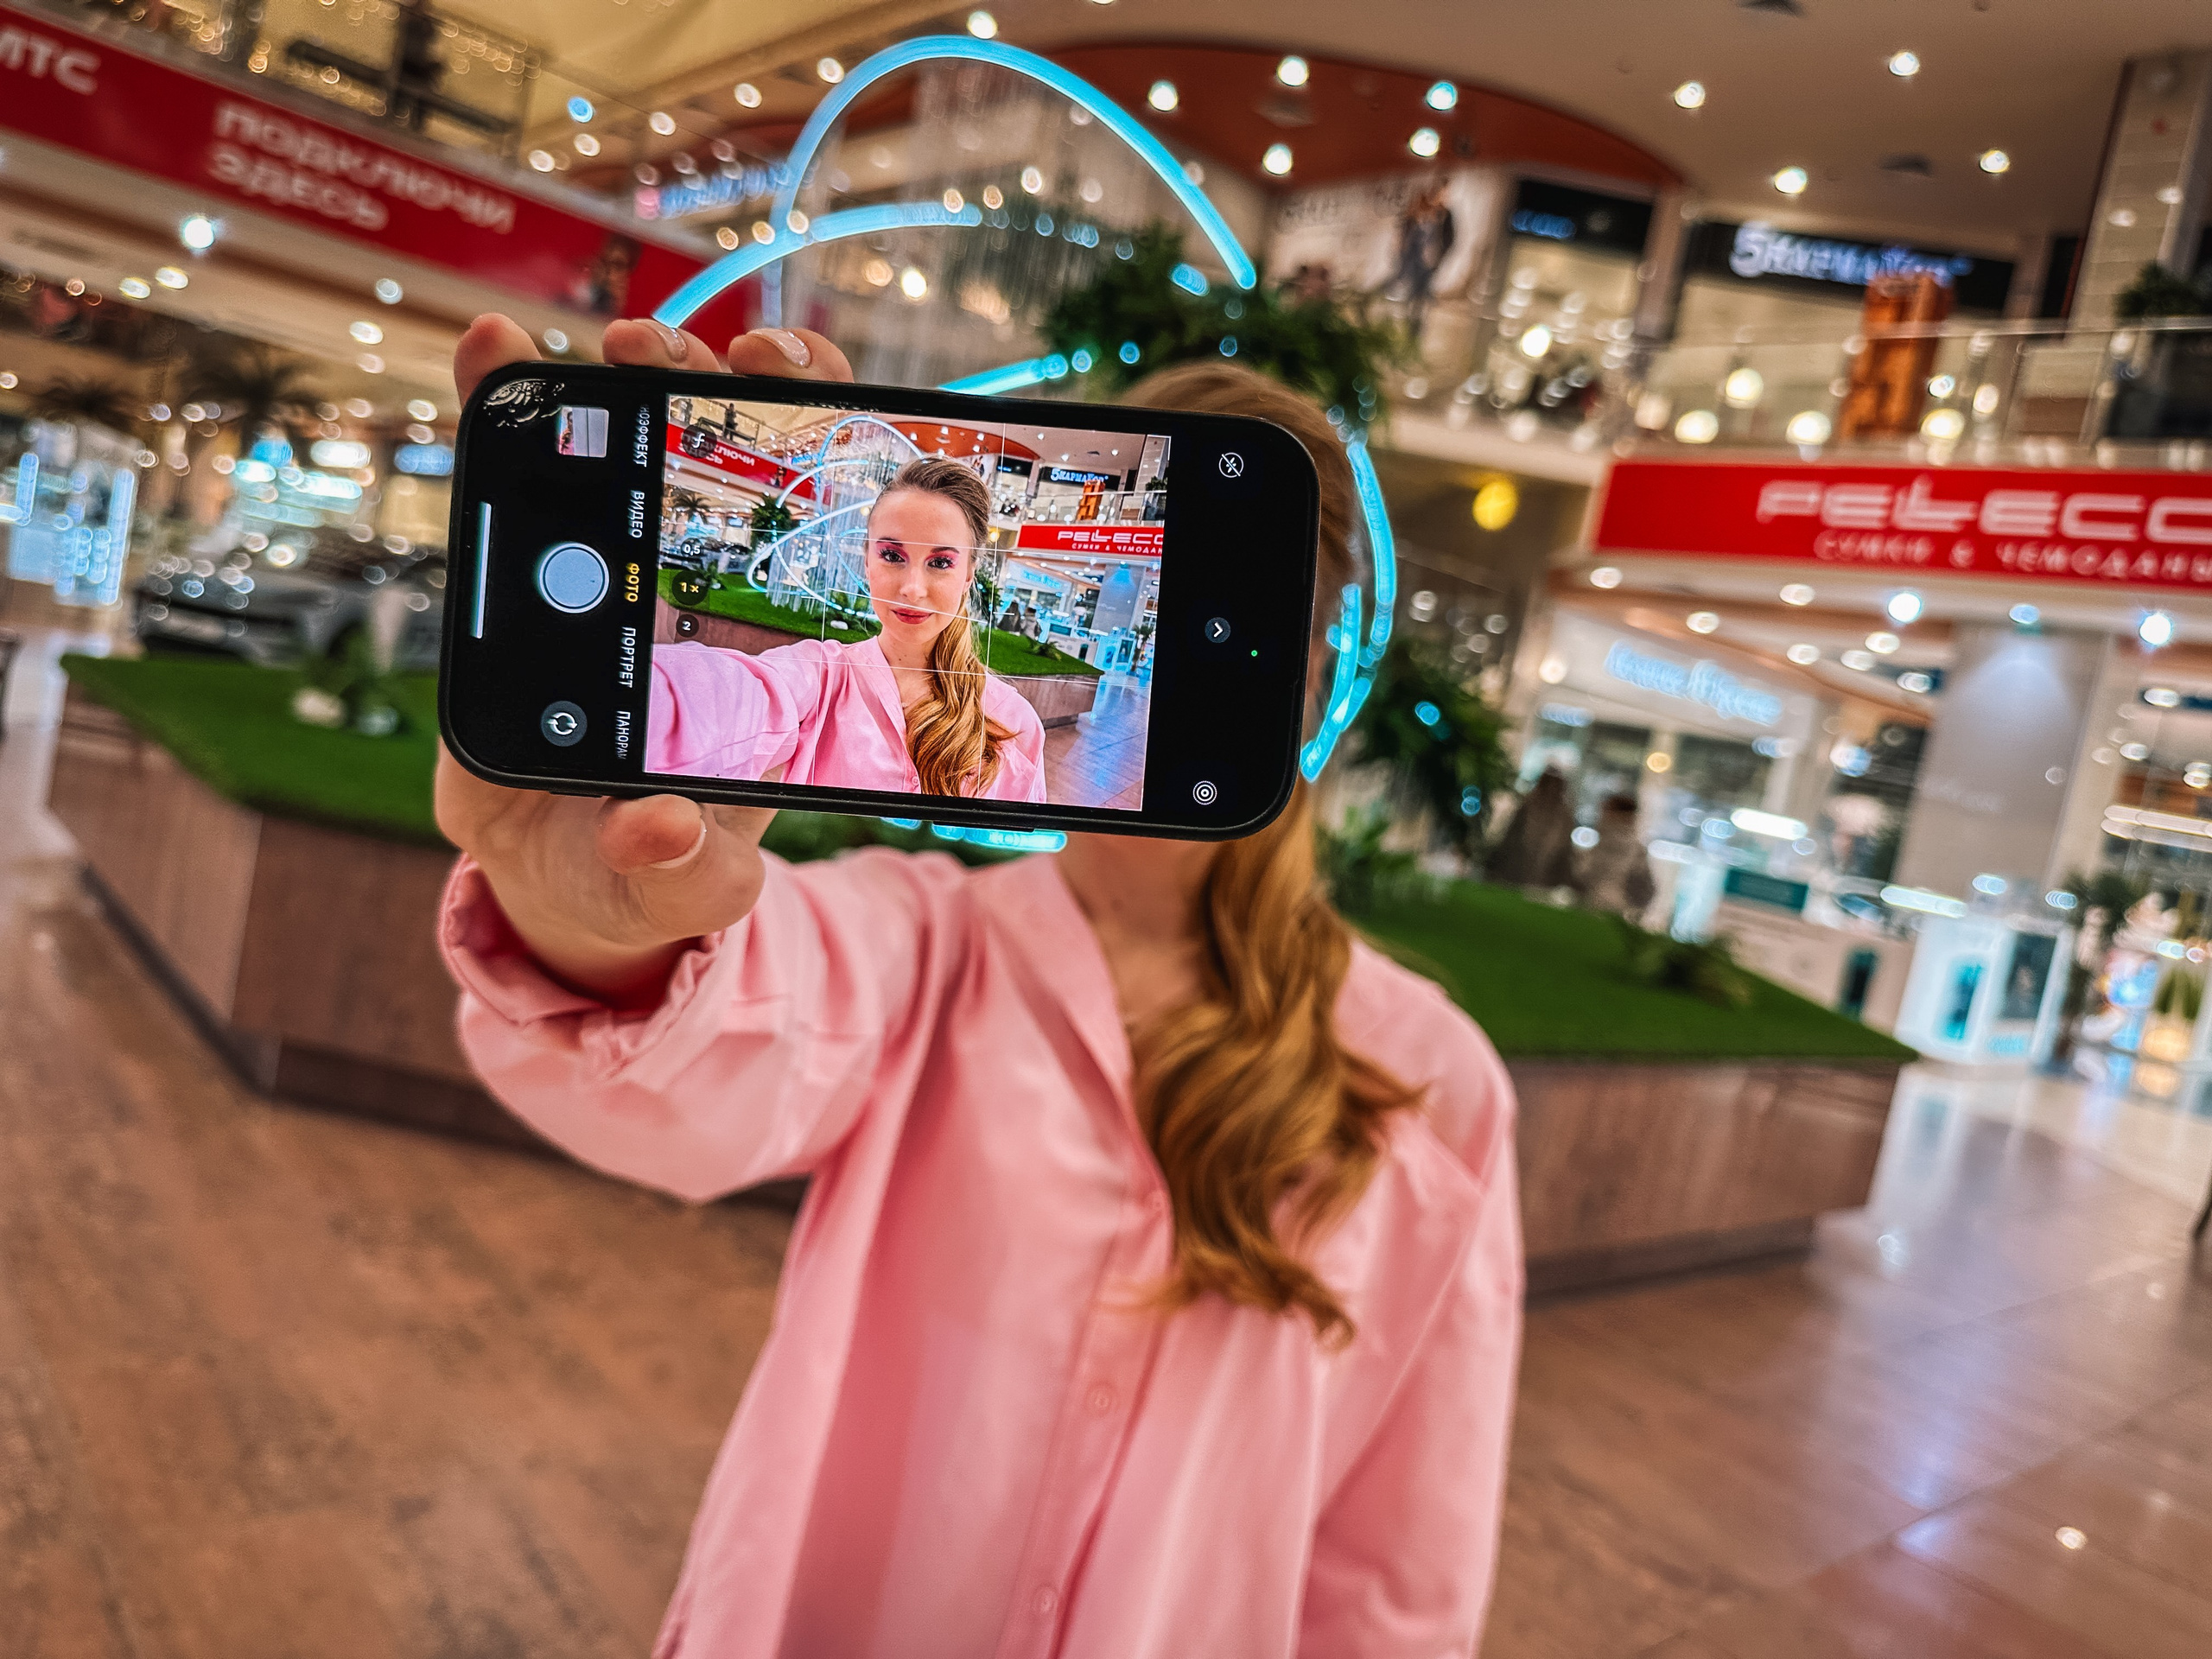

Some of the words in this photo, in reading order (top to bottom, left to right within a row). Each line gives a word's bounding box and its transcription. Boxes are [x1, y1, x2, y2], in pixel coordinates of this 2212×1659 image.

[206, 143, 388, 231] ЗДЕСЬ
[216, 102, 516, 234] ПОДКЛЮЧИ
[630, 489, 645, 539] ВИДЕО
[683, 543, 701, 556] 0,5
[626, 563, 639, 603] ФОТО
[683, 621, 691, 631] 2
[620, 626, 637, 689] ПОРТРЕТ
